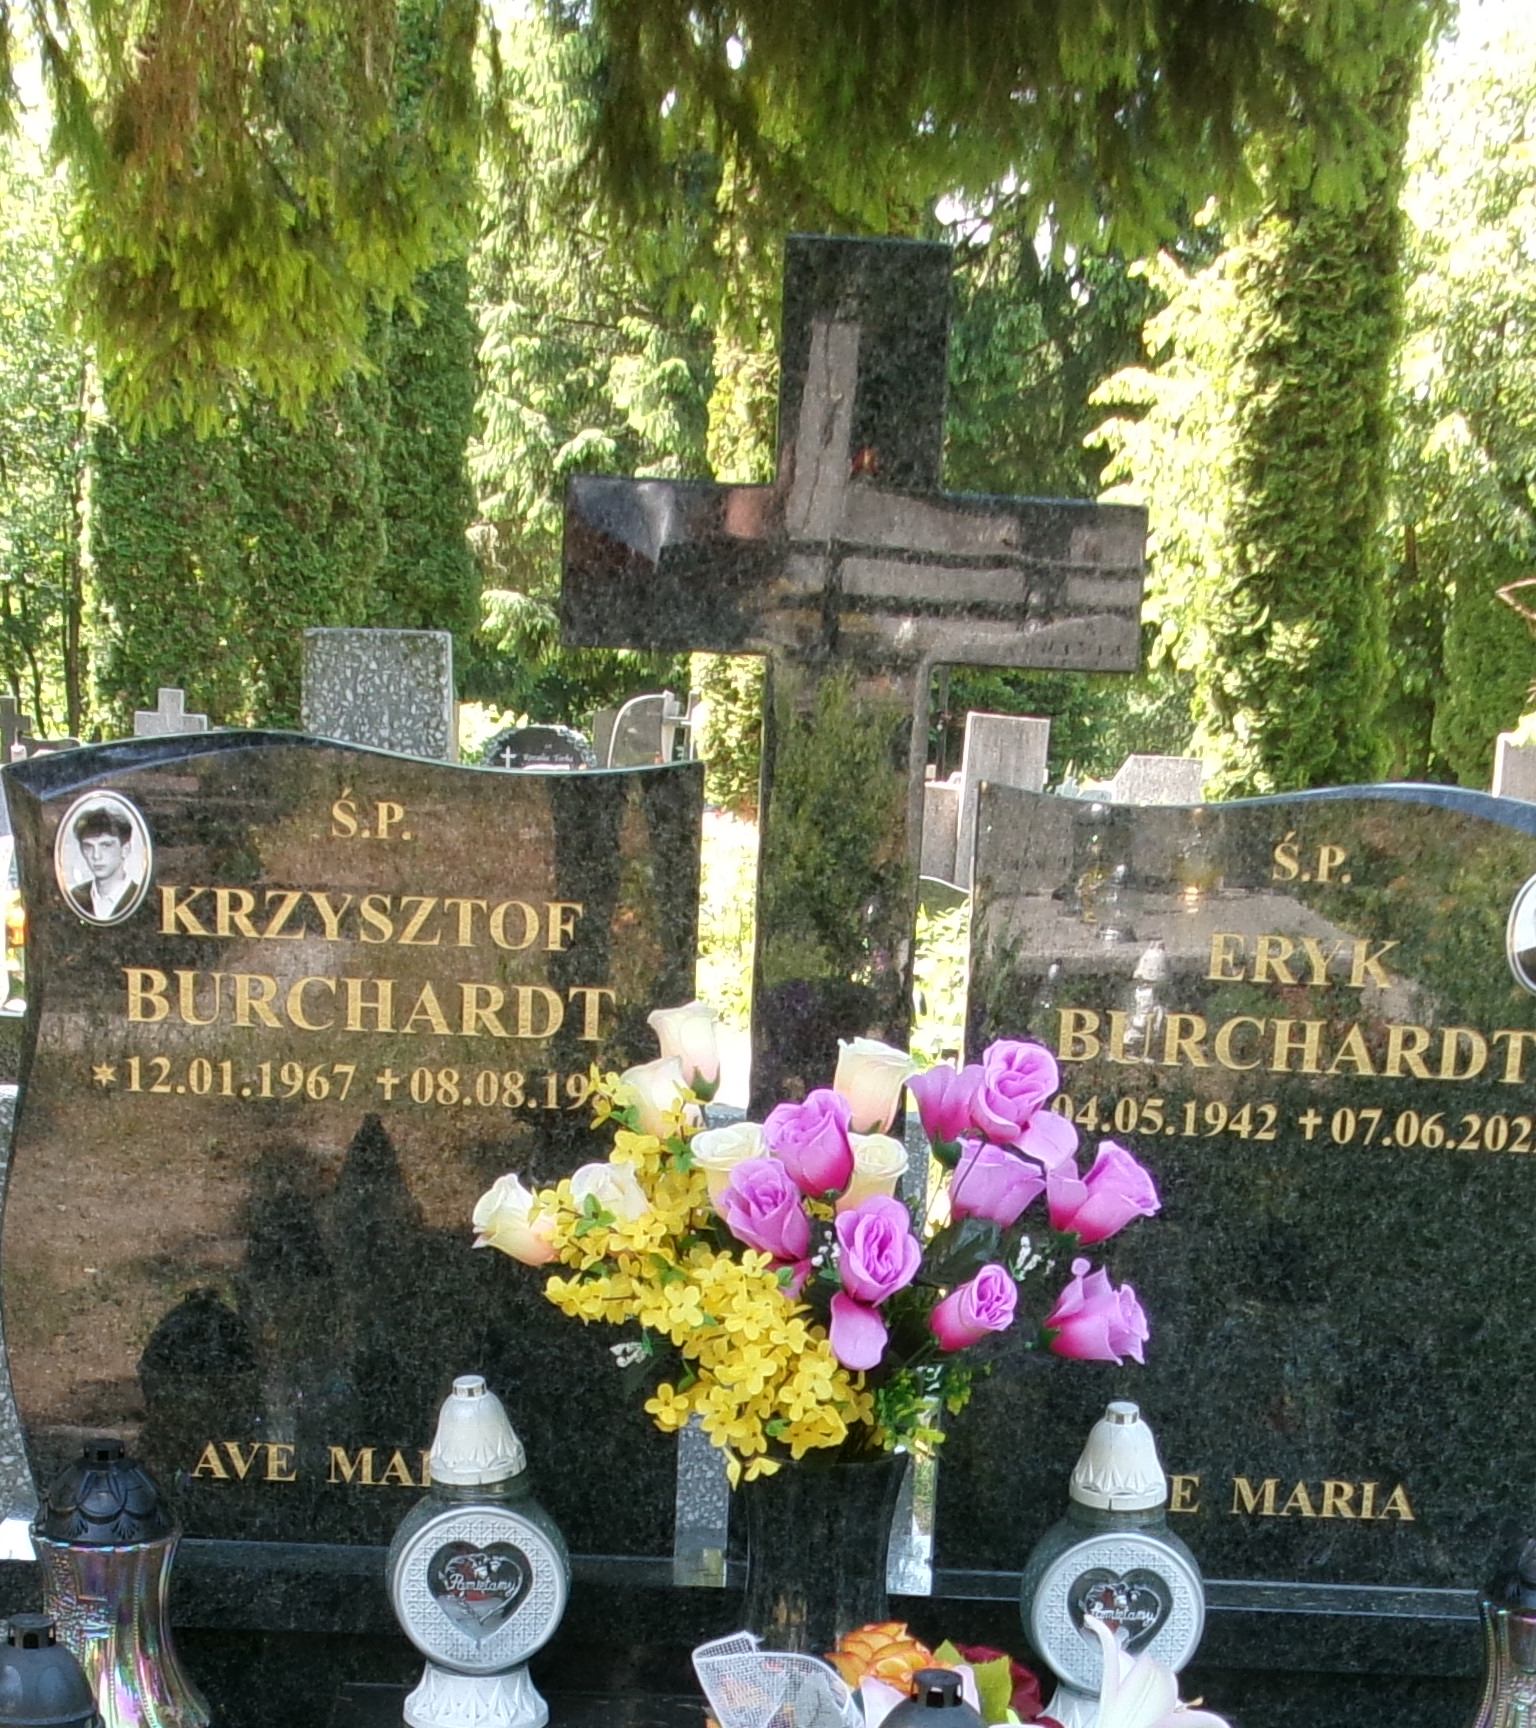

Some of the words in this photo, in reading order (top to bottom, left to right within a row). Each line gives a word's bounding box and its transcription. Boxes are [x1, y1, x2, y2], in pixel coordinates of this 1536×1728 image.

[332, 788, 412, 840] Ś.P.
[1272, 831, 1352, 883] Ś.P.
[157, 885, 583, 951] KRZYSZTOF
[1205, 932, 1400, 988] ERYK
[122, 966, 616, 1042] BURCHARDT
[126, 1056, 357, 1101] 12.01.1967
[410, 1067, 610, 1111] 08.08.19
[191, 1441, 297, 1482] AVE
[1230, 1476, 1416, 1521] MARIA
